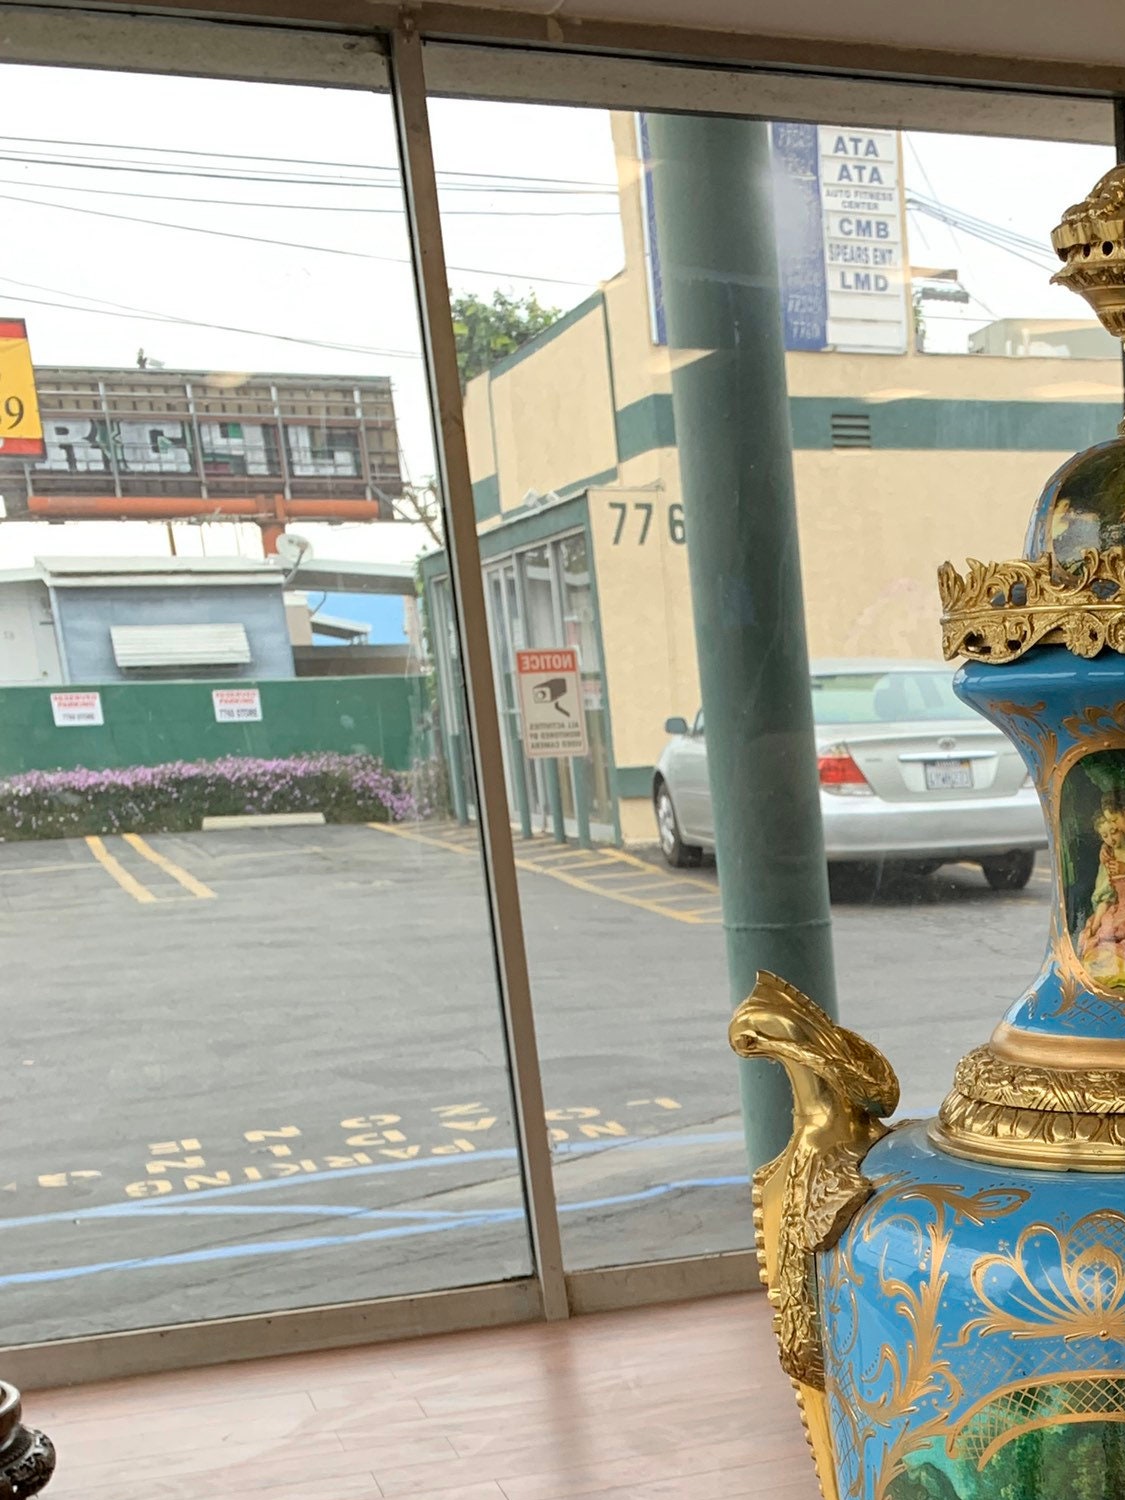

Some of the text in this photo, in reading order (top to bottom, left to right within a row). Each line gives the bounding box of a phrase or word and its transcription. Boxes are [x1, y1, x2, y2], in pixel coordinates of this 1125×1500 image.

[833, 136, 879, 158] ATA
[837, 164, 884, 185] ATA
[826, 188, 893, 202] AUTO FITNESS
[841, 200, 879, 211] CENTER
[839, 218, 890, 239] CMB
[828, 243, 869, 263] SPEARS
[840, 271, 889, 292] LMD
[124, 1138, 476, 1198] PARKING
